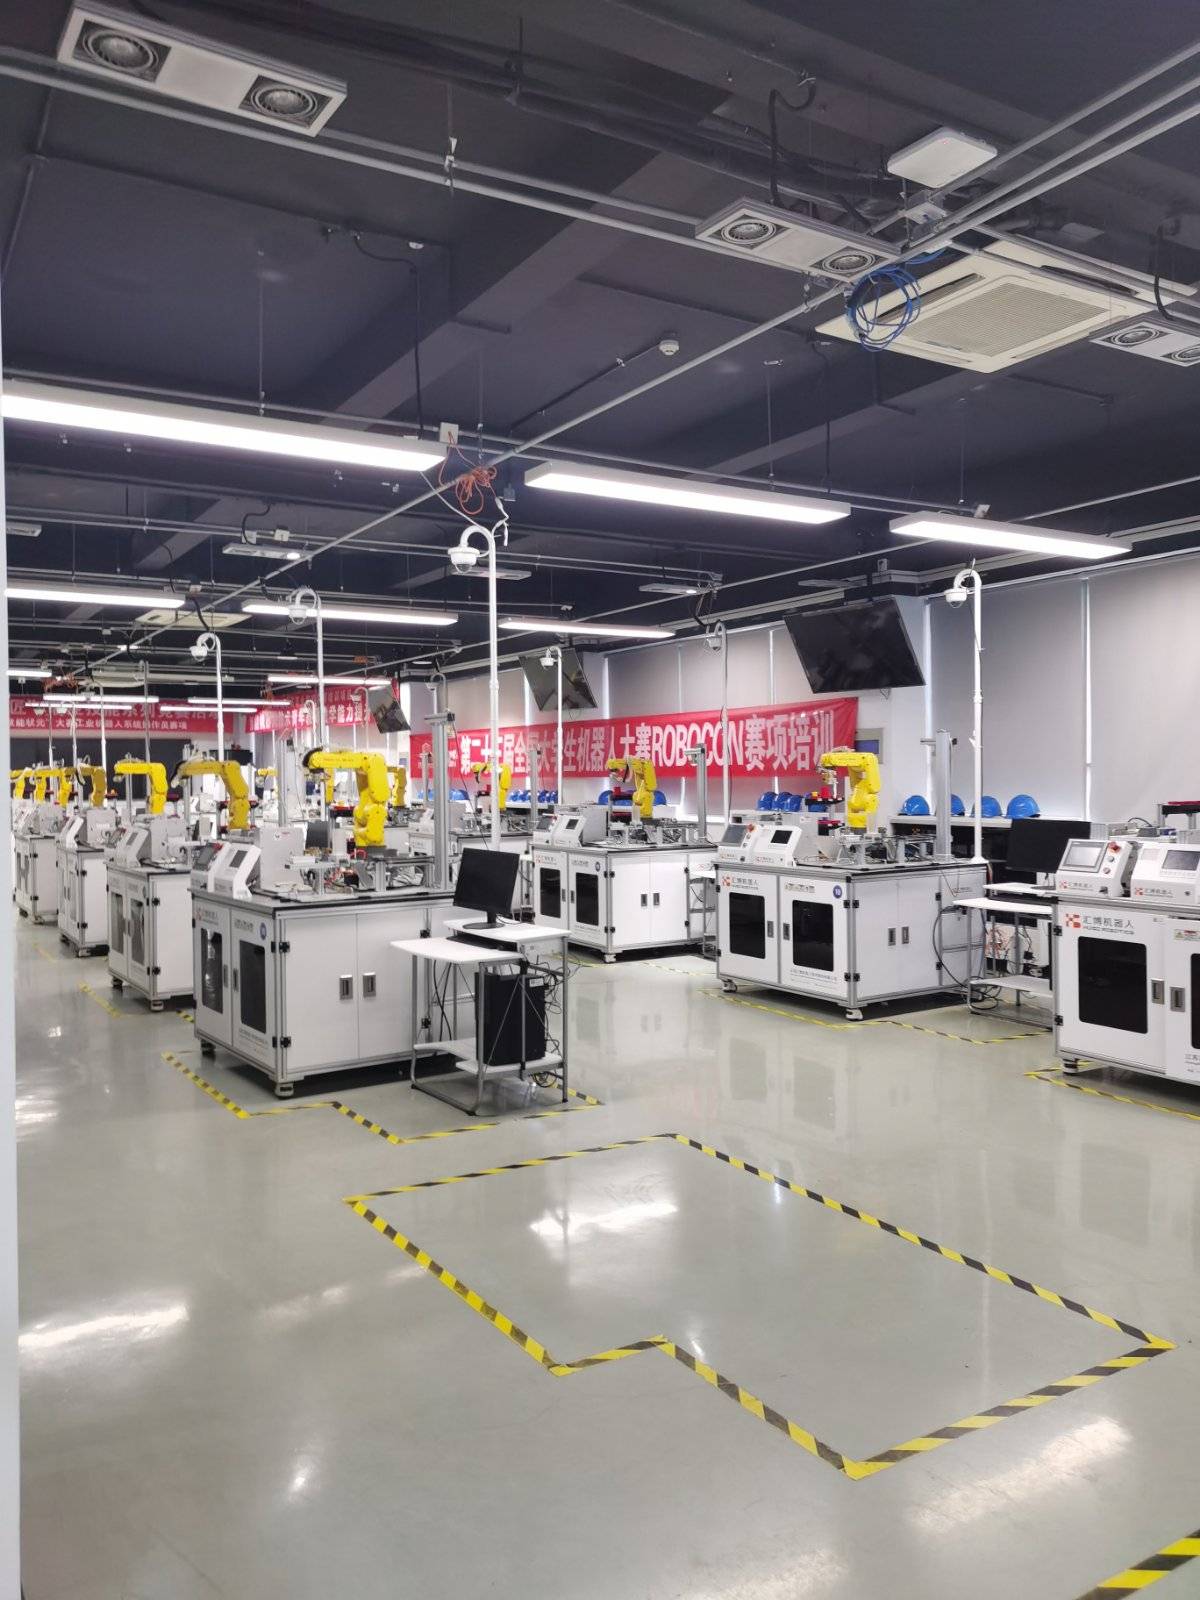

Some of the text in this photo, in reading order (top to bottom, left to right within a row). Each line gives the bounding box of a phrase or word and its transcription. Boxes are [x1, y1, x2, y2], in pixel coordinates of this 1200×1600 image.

[1083, 916, 1135, 929] 汇博机器人
